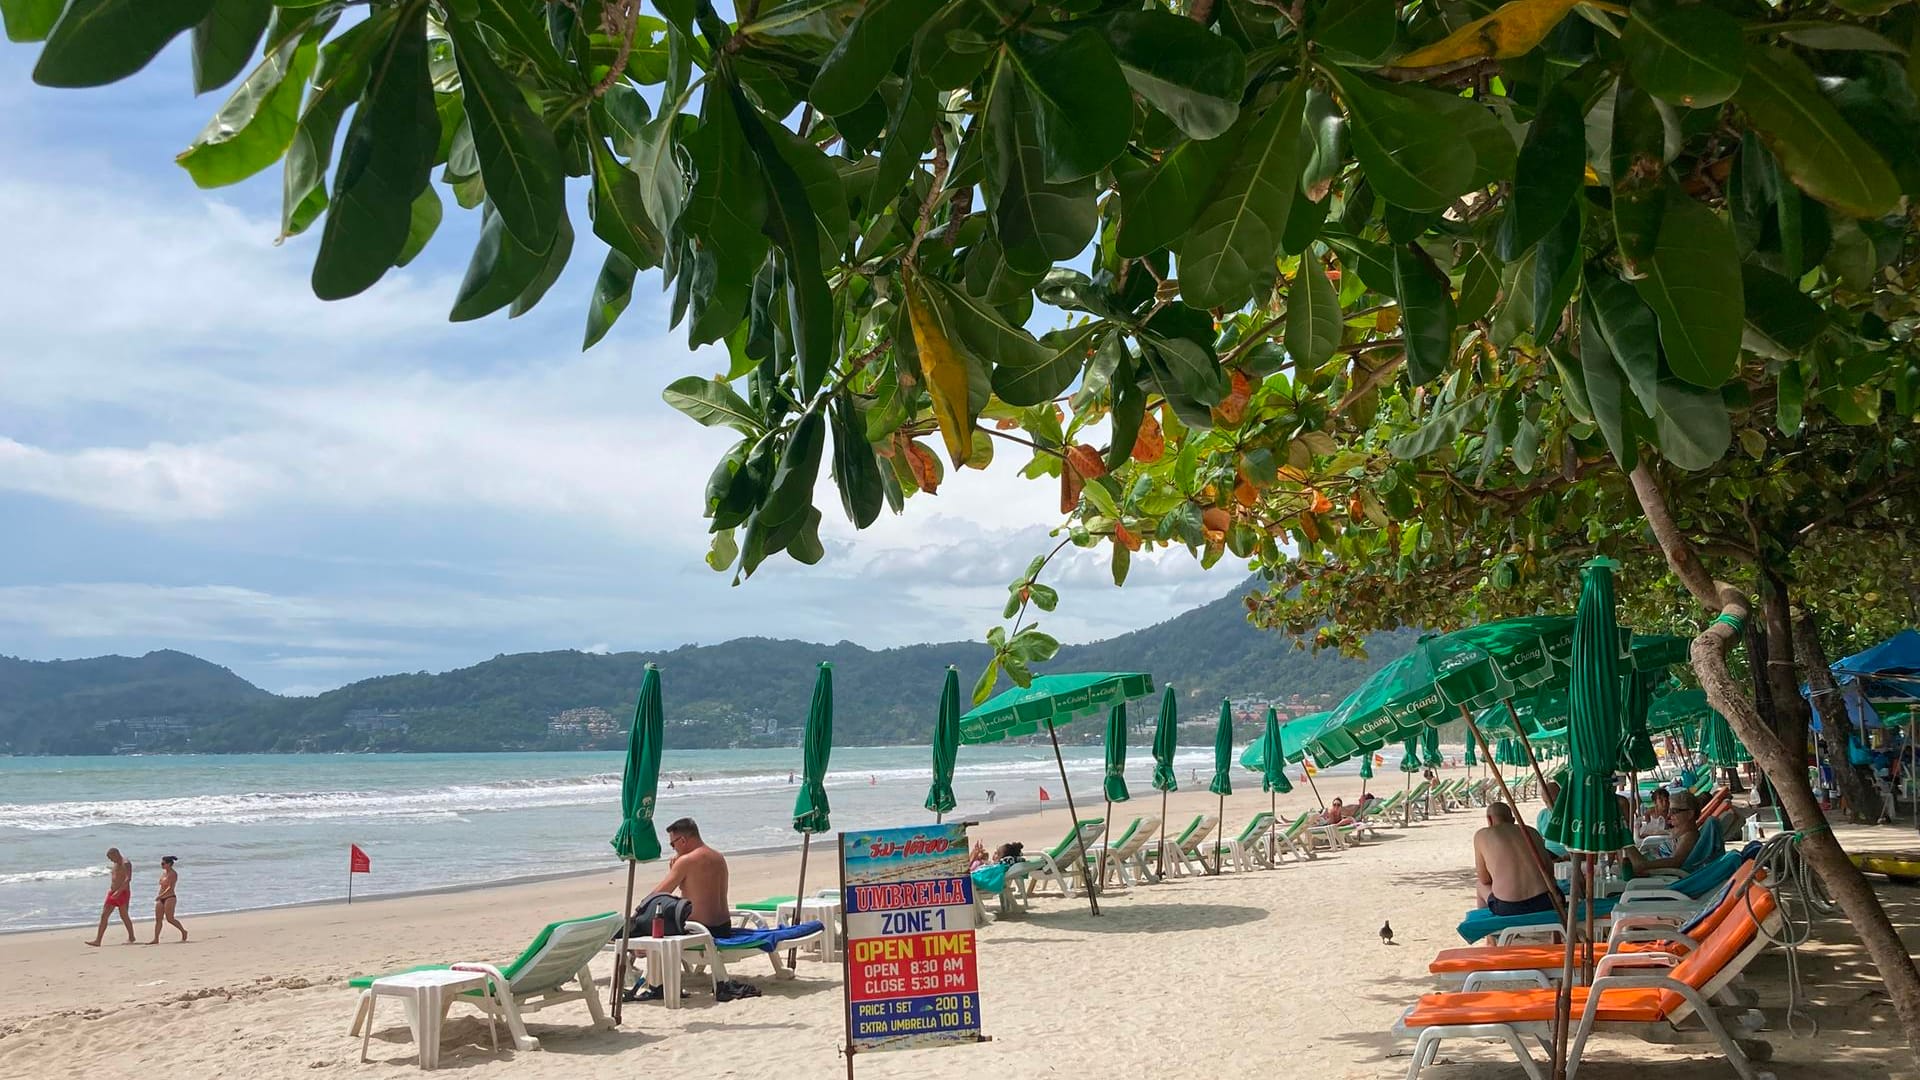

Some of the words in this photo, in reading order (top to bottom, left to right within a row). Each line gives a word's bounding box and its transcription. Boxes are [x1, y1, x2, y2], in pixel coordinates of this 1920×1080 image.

[1406, 694, 1438, 714] Chang
[1362, 714, 1391, 733] Chang
[856, 879, 965, 912] UMBRELLA
[881, 910, 933, 935] ZONE
[936, 908, 947, 930] 1
[855, 938, 914, 963] OPEN
[921, 933, 973, 957] TIME
[864, 963, 899, 978] OPEN
[910, 959, 938, 975] 8:30
[943, 957, 963, 971] AM
[865, 978, 906, 994] CLOSE
[944, 973, 965, 988] PM
[859, 1003, 885, 1017] PRICE
[889, 1002, 893, 1014] 1
[896, 1001, 912, 1013] SET
[935, 996, 958, 1011] 200
[962, 995, 974, 1009] B.
[860, 1021, 887, 1034] EXTRA
[891, 1017, 937, 1032] UMBRELLA
[939, 1012, 959, 1027] 100
[963, 1011, 975, 1025] B.
